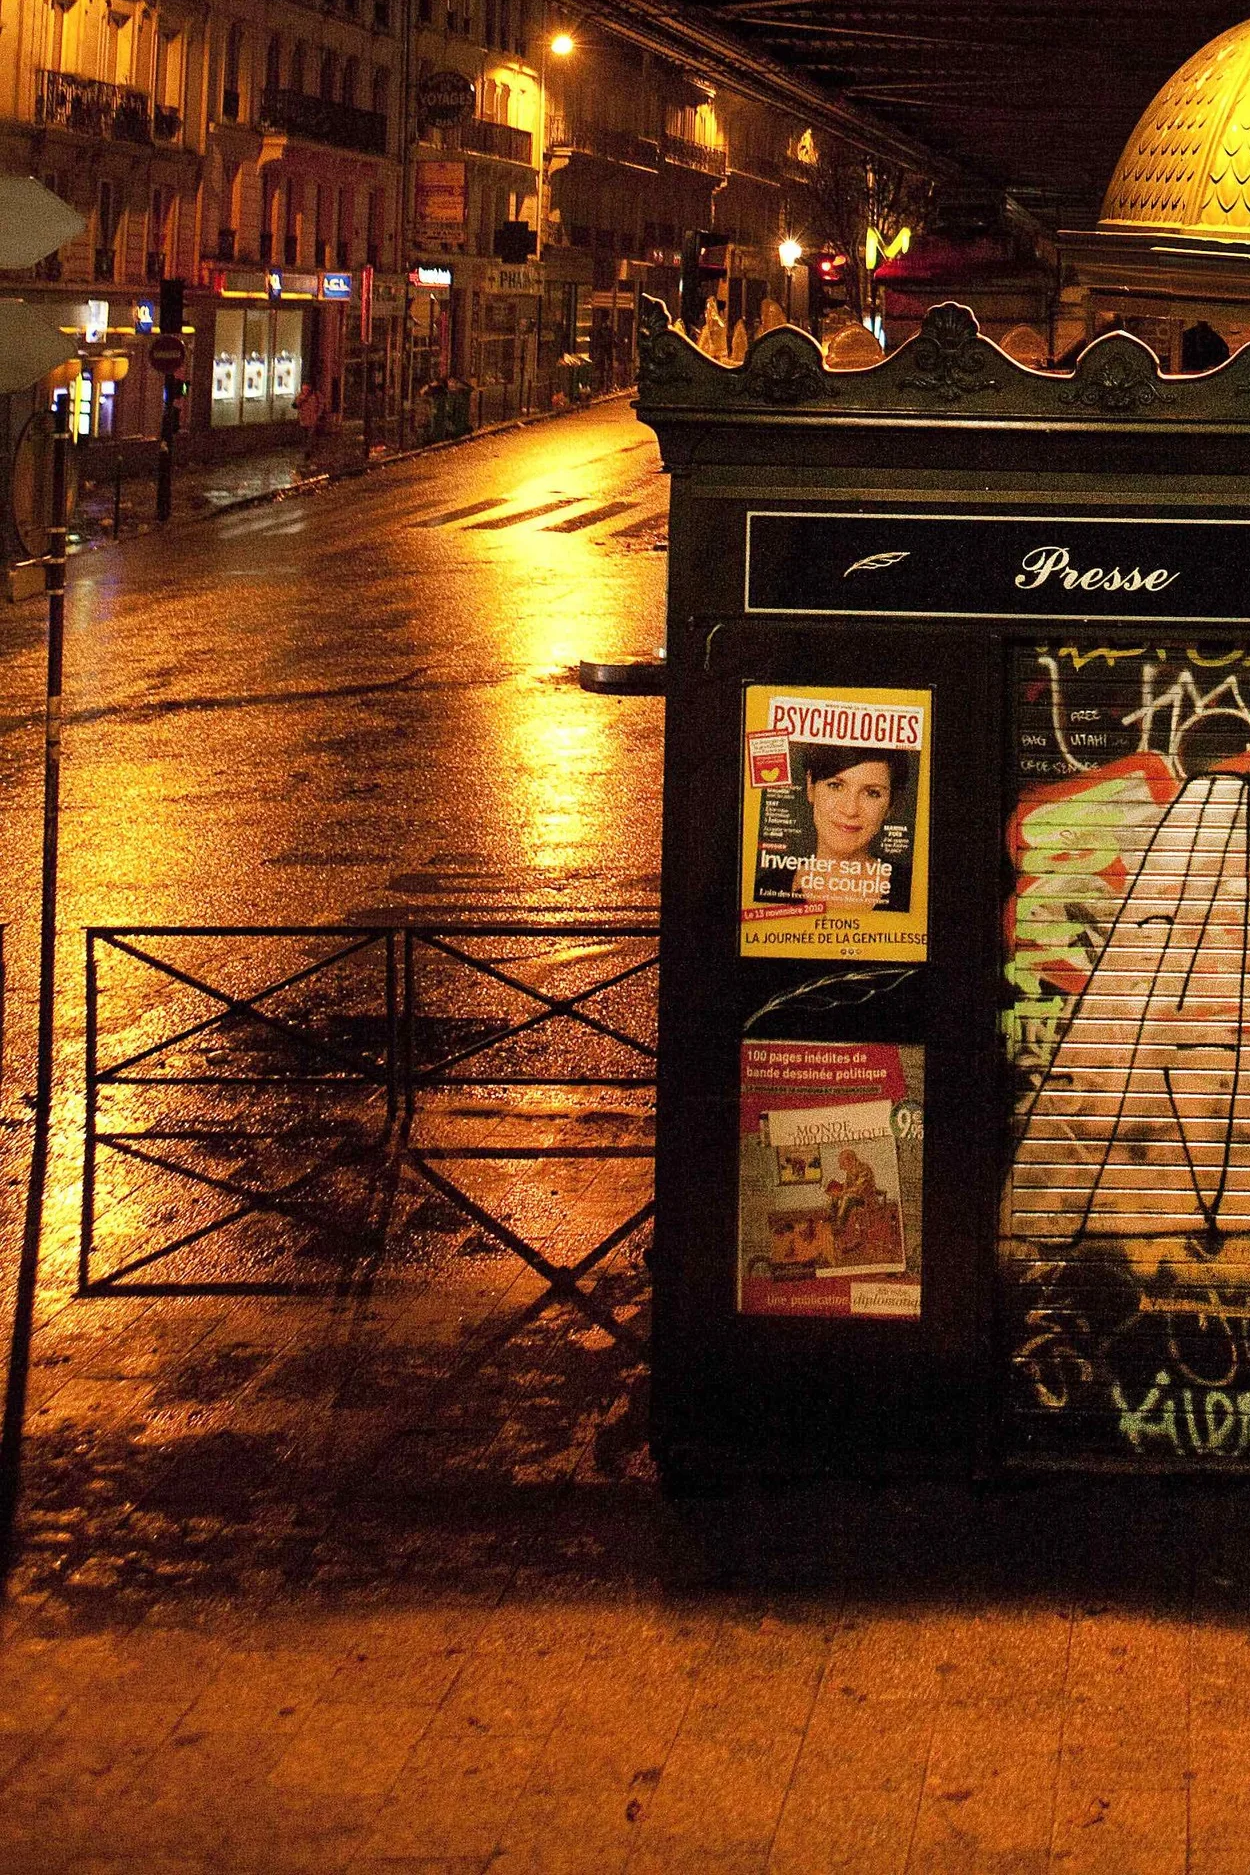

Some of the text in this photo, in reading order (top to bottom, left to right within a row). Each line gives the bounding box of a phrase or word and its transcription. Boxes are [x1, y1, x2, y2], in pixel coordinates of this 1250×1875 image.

[420, 92, 473, 106] VOYAGES
[1014, 544, 1179, 596] Presse
[773, 704, 919, 745] PSYCHOLOGIES
[760, 849, 893, 877] Inventer sa vie
[801, 873, 892, 898] de couple
[814, 916, 860, 930] FÊTONS
[746, 930, 928, 946] LA JOURNÉE DE LA GENTILLESSE
[746, 1051, 867, 1065] 100 pages inédites de
[746, 1067, 888, 1081] bande dessinée politique
[796, 1120, 852, 1136] MONDE
